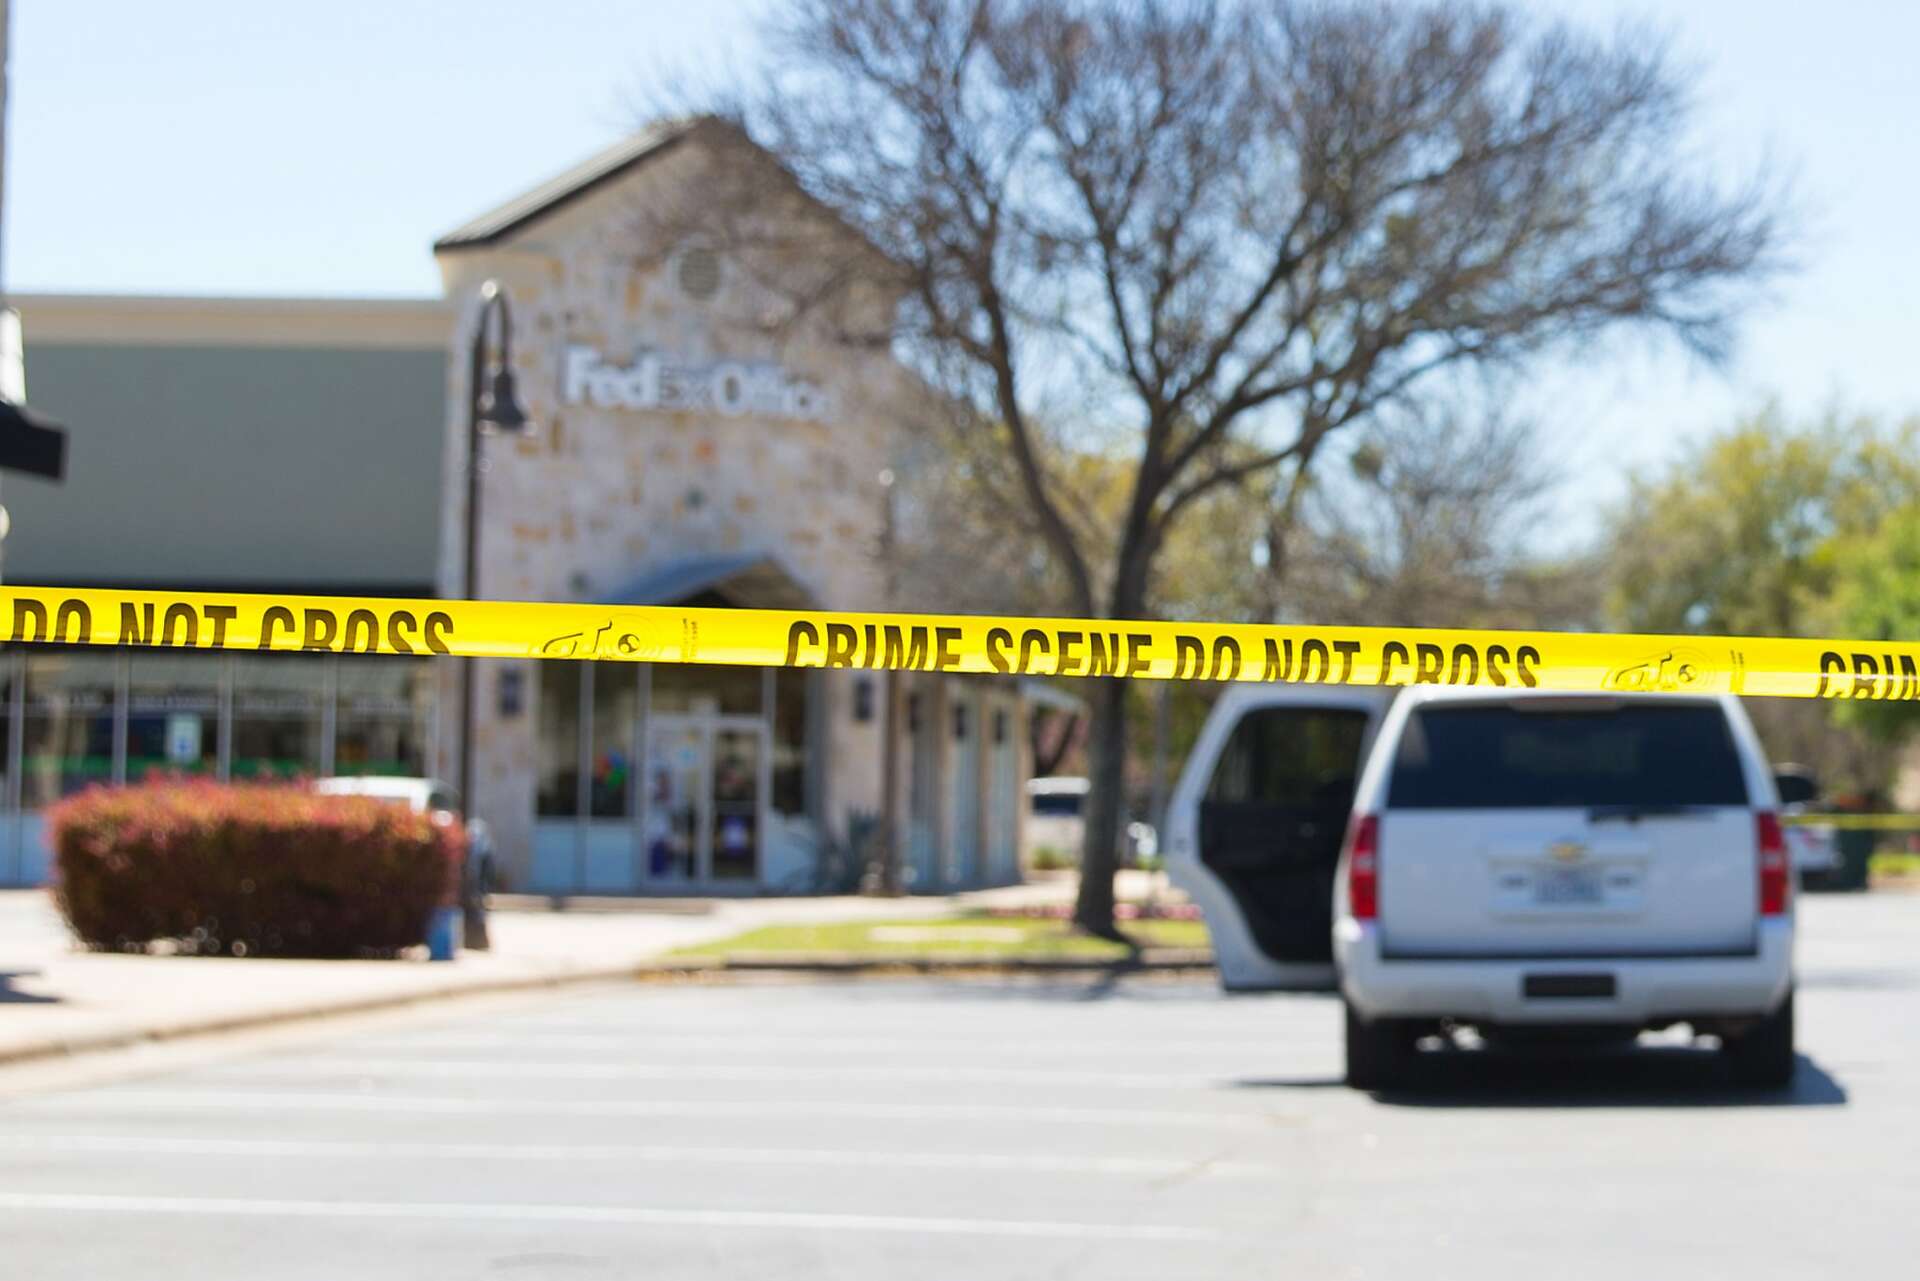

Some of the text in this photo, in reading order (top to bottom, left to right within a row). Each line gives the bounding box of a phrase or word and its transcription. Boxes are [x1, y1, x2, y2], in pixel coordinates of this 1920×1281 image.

[11, 598, 454, 655] DO NOT CROSS
[786, 620, 1541, 688] CRIME SCENE DO NOT CROSS
